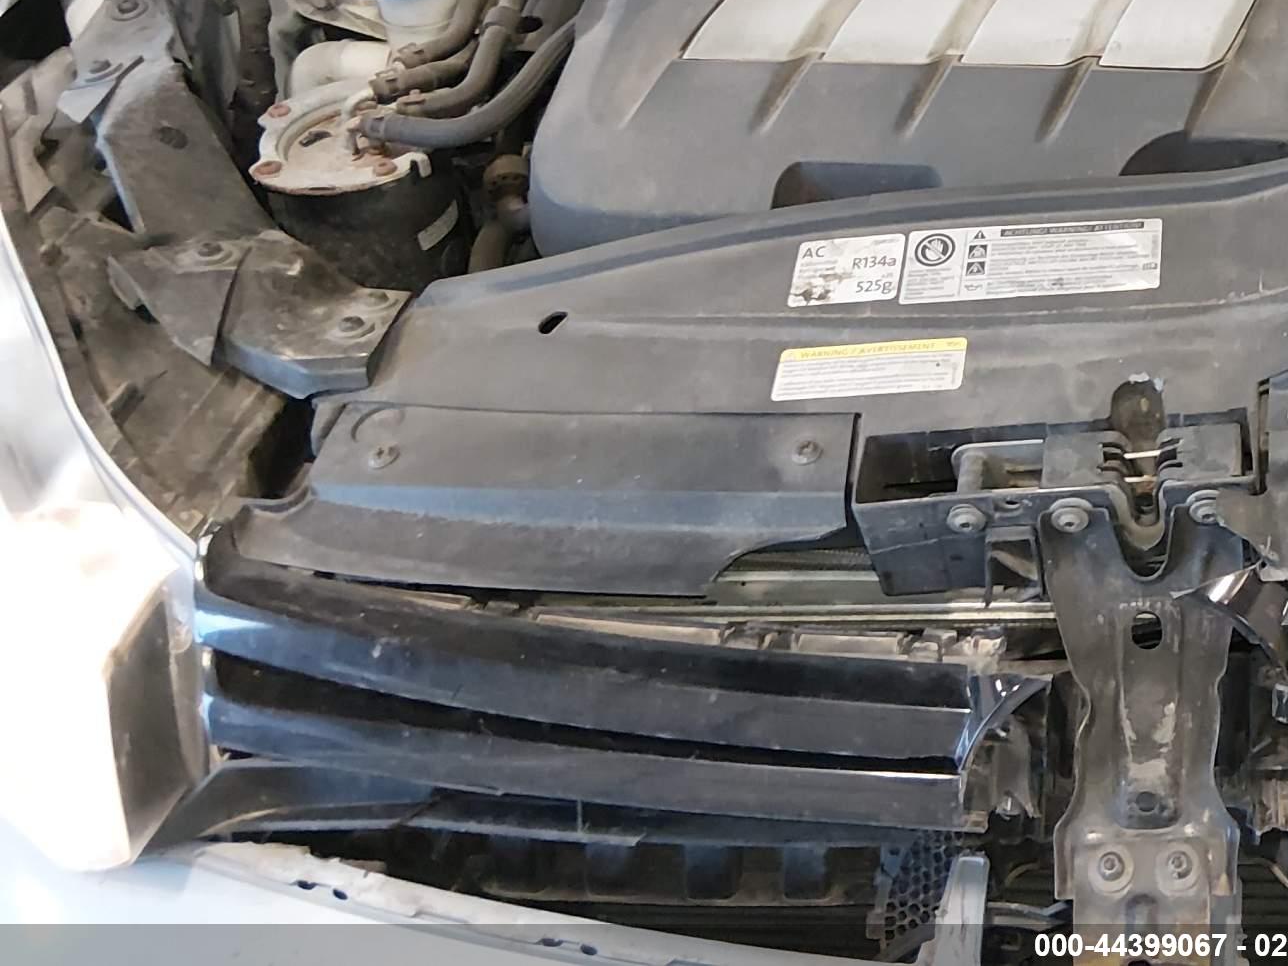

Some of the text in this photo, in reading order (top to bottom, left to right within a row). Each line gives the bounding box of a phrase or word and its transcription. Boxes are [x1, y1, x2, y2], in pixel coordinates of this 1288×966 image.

[802, 246, 826, 259] AC
[852, 255, 897, 270] R134a
[855, 280, 893, 294] 525g
[801, 348, 849, 359] WARNING
[857, 341, 936, 355] AVERTISSEMENT
